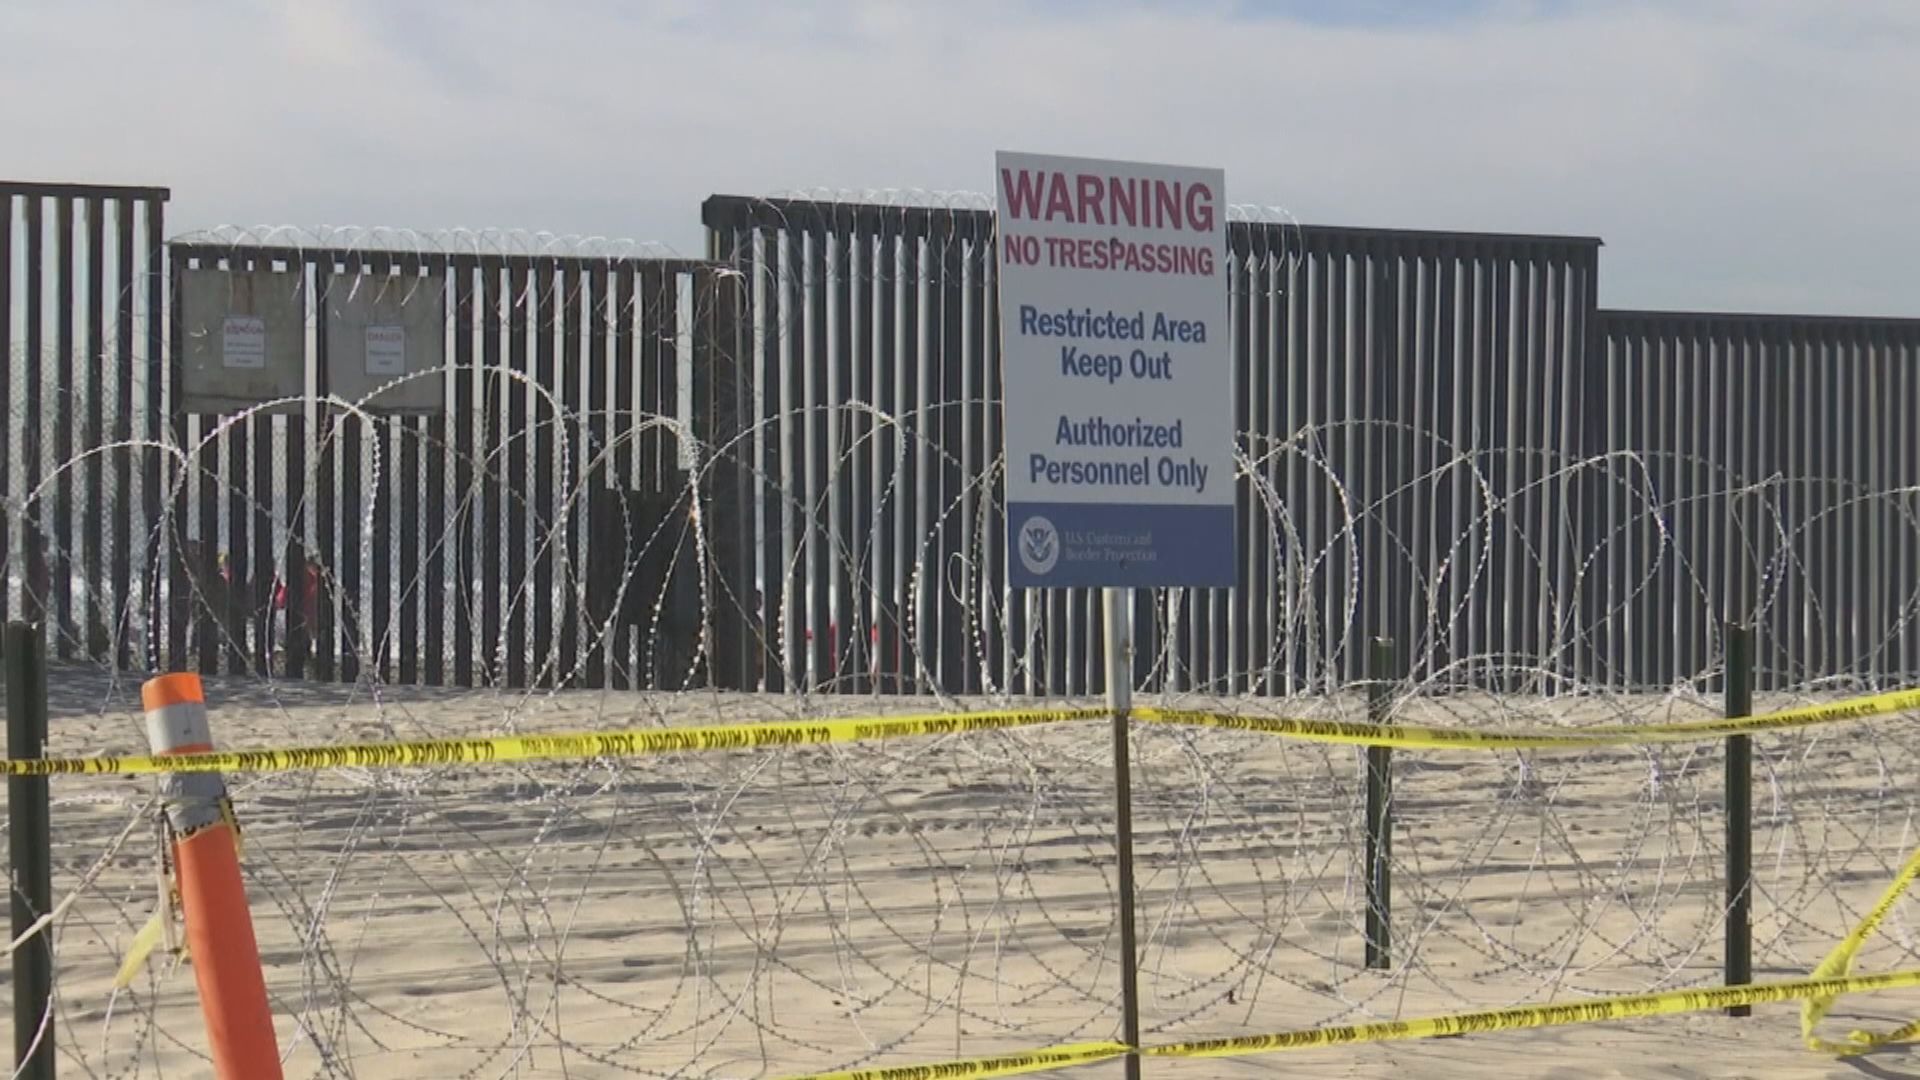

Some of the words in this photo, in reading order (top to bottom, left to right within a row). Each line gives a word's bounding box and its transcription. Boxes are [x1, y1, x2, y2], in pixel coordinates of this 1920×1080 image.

[1001, 168, 1214, 232] WARNING
[1004, 234, 1041, 266] NO
[1045, 237, 1214, 276] TRESPASSING
[1019, 304, 1145, 341] Restricted
[1152, 311, 1207, 343] Area
[1061, 345, 1122, 384] Keep
[1129, 348, 1172, 380] Out
[1055, 415, 1182, 448] Authorized
[1029, 453, 1150, 485] Personnel
[1157, 456, 1208, 493] Only
[1134, 530, 1152, 545] and
